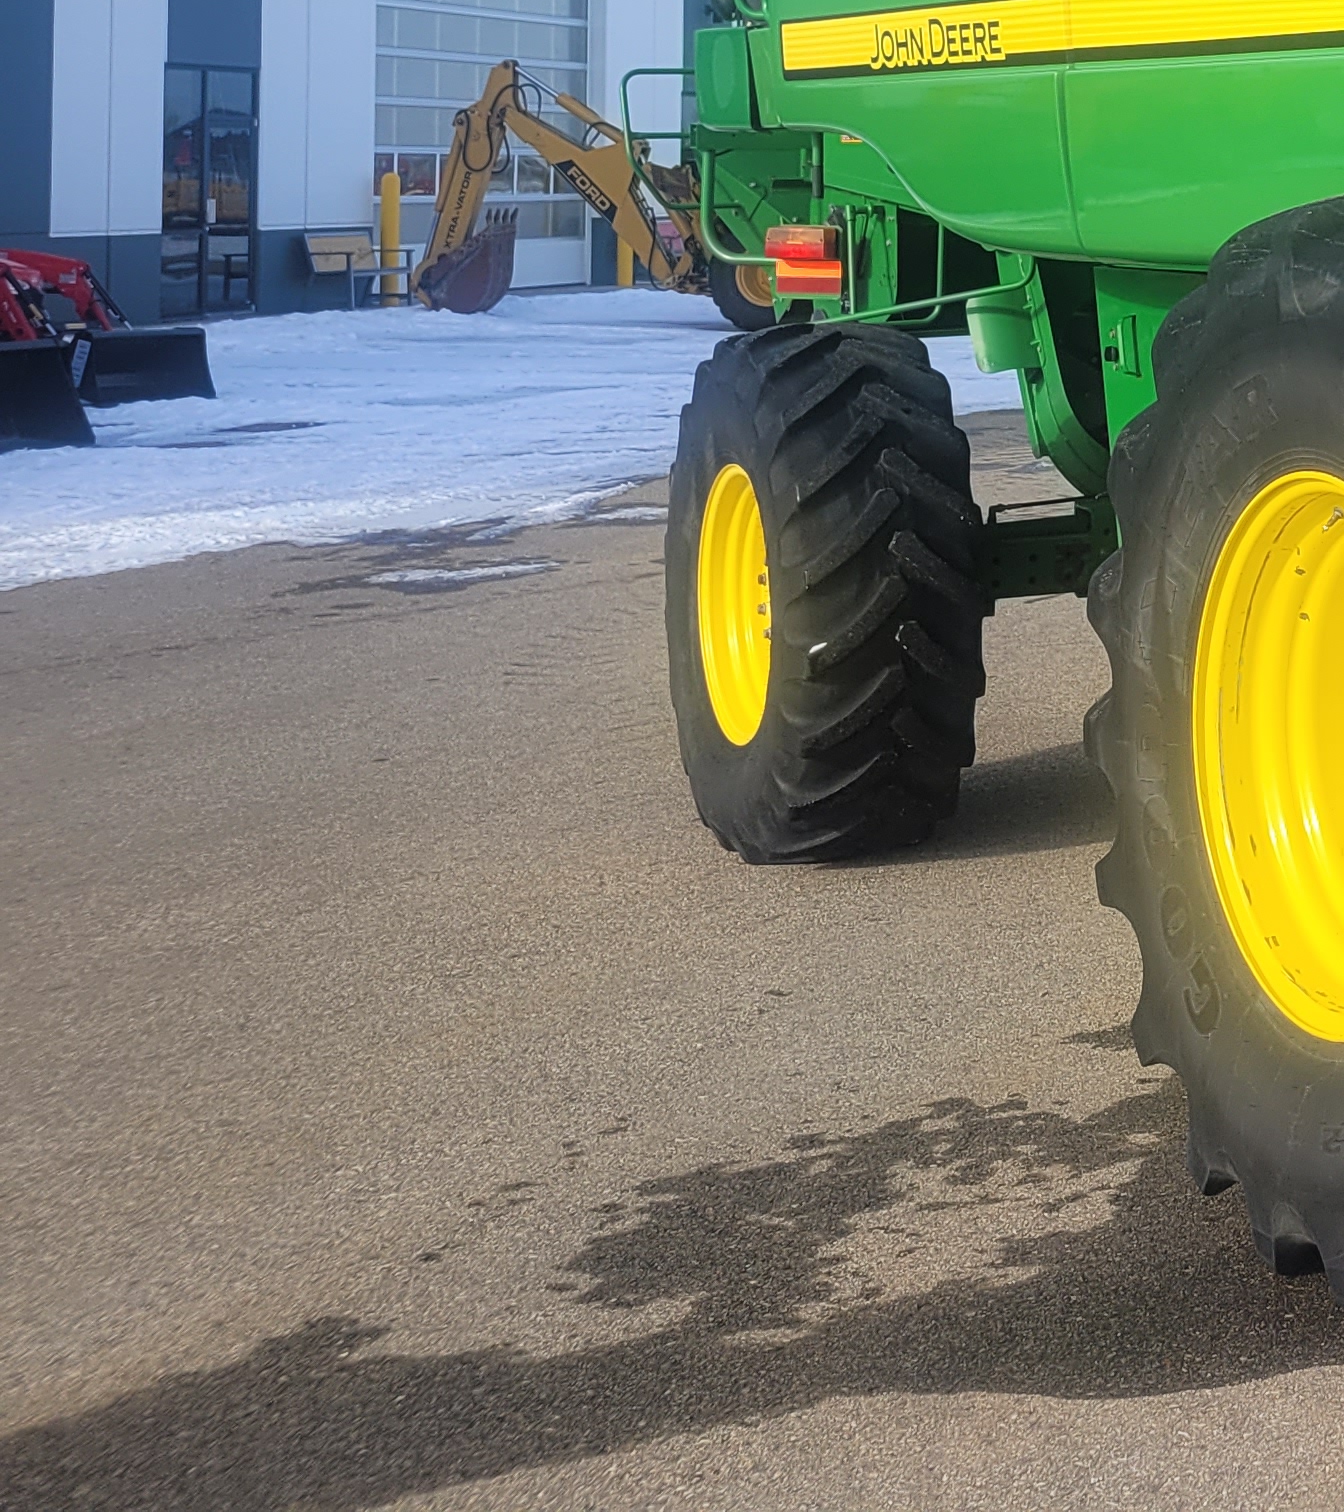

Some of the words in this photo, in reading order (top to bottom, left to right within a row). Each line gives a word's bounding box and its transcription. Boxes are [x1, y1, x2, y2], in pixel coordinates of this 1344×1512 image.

[870, 23, 926, 65] JOHN
[928, 18, 1003, 59] DEERE
[567, 166, 611, 212] FORD
